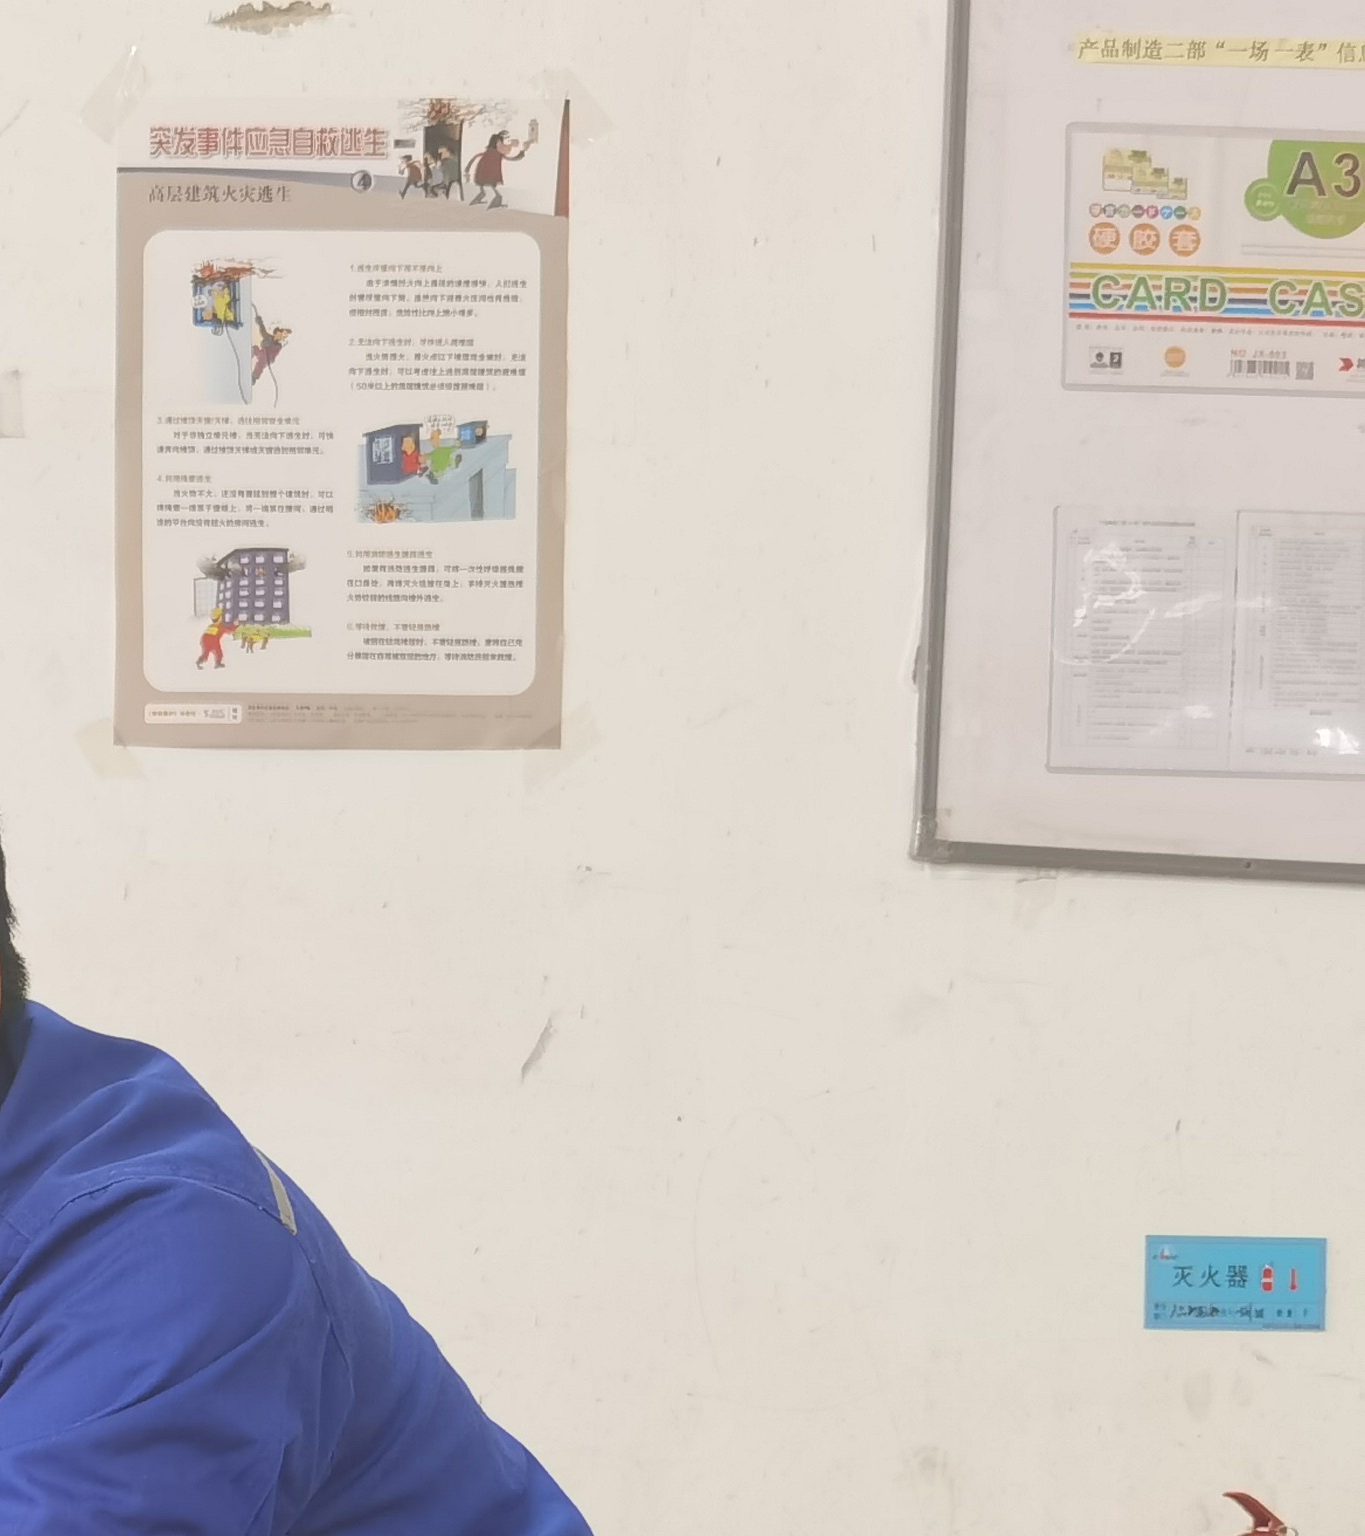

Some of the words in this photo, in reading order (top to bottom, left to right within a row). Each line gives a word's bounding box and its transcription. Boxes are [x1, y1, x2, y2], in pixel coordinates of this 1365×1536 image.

[148, 125, 389, 158] 突发事件应急自救逃生
[1285, 151, 1362, 199] A3
[148, 183, 293, 204] 高层建筑火灾逃生
[1091, 274, 1228, 313] CARD
[1172, 1264, 1249, 1289] 灭火器
